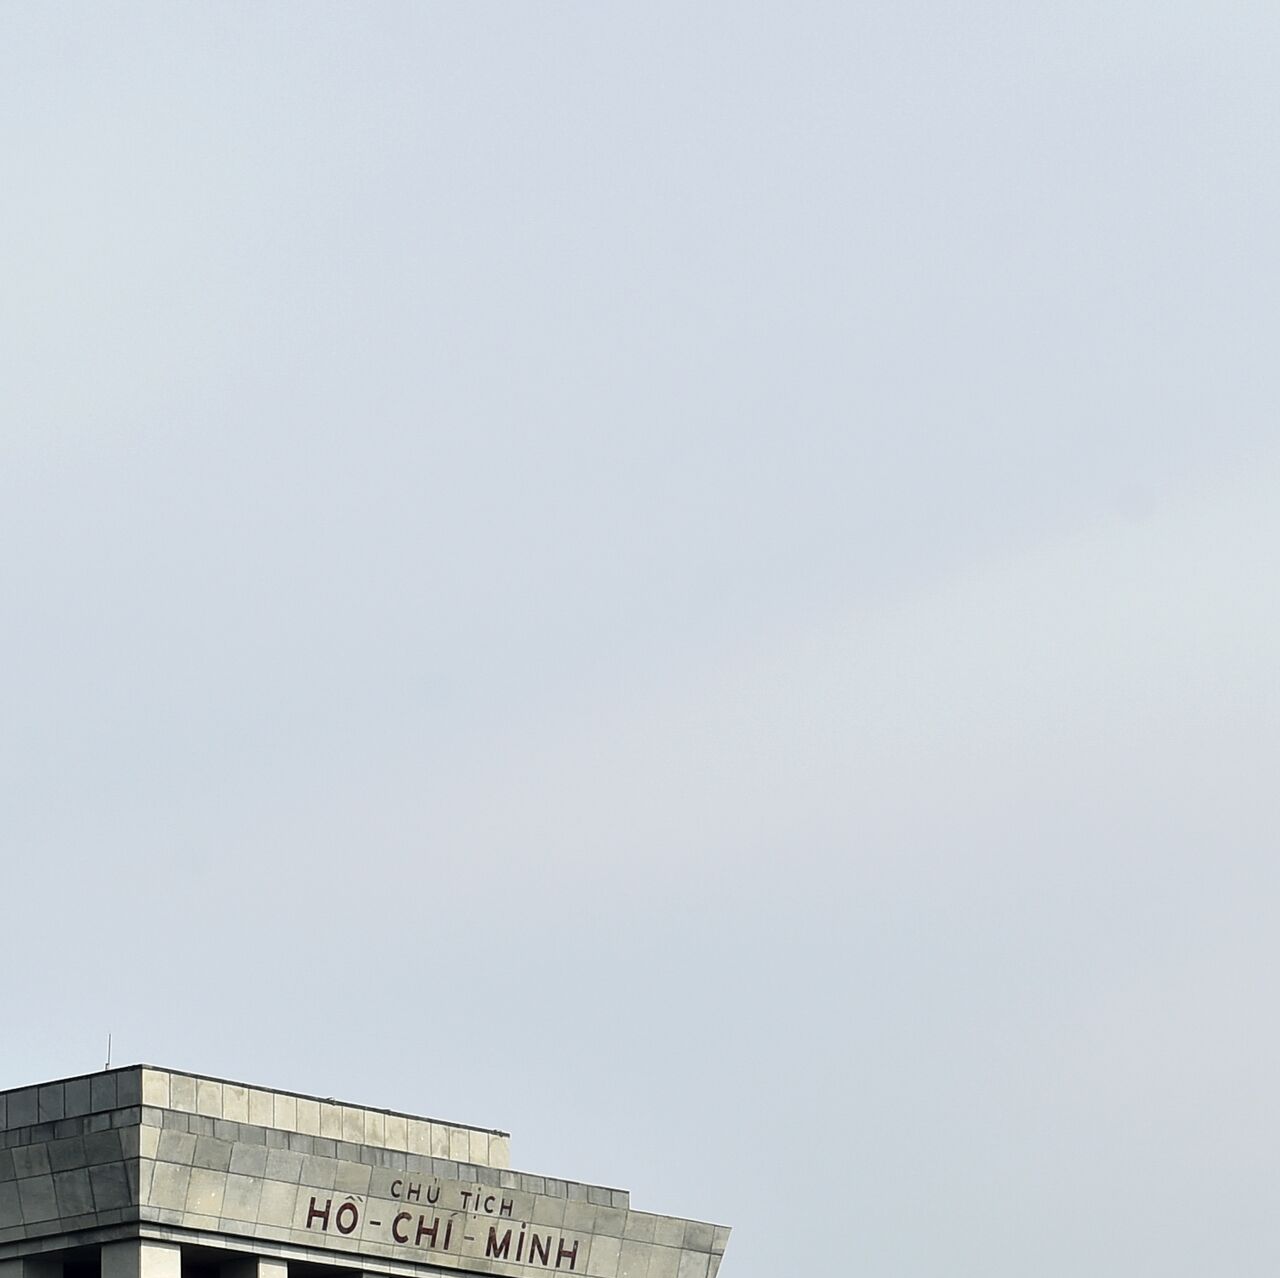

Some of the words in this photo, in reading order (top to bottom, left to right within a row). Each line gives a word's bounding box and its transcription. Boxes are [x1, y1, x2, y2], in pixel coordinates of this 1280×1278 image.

[390, 1177, 440, 1204] CHỦ
[306, 1195, 363, 1234] HỒ
[392, 1212, 458, 1250] CHÍ
